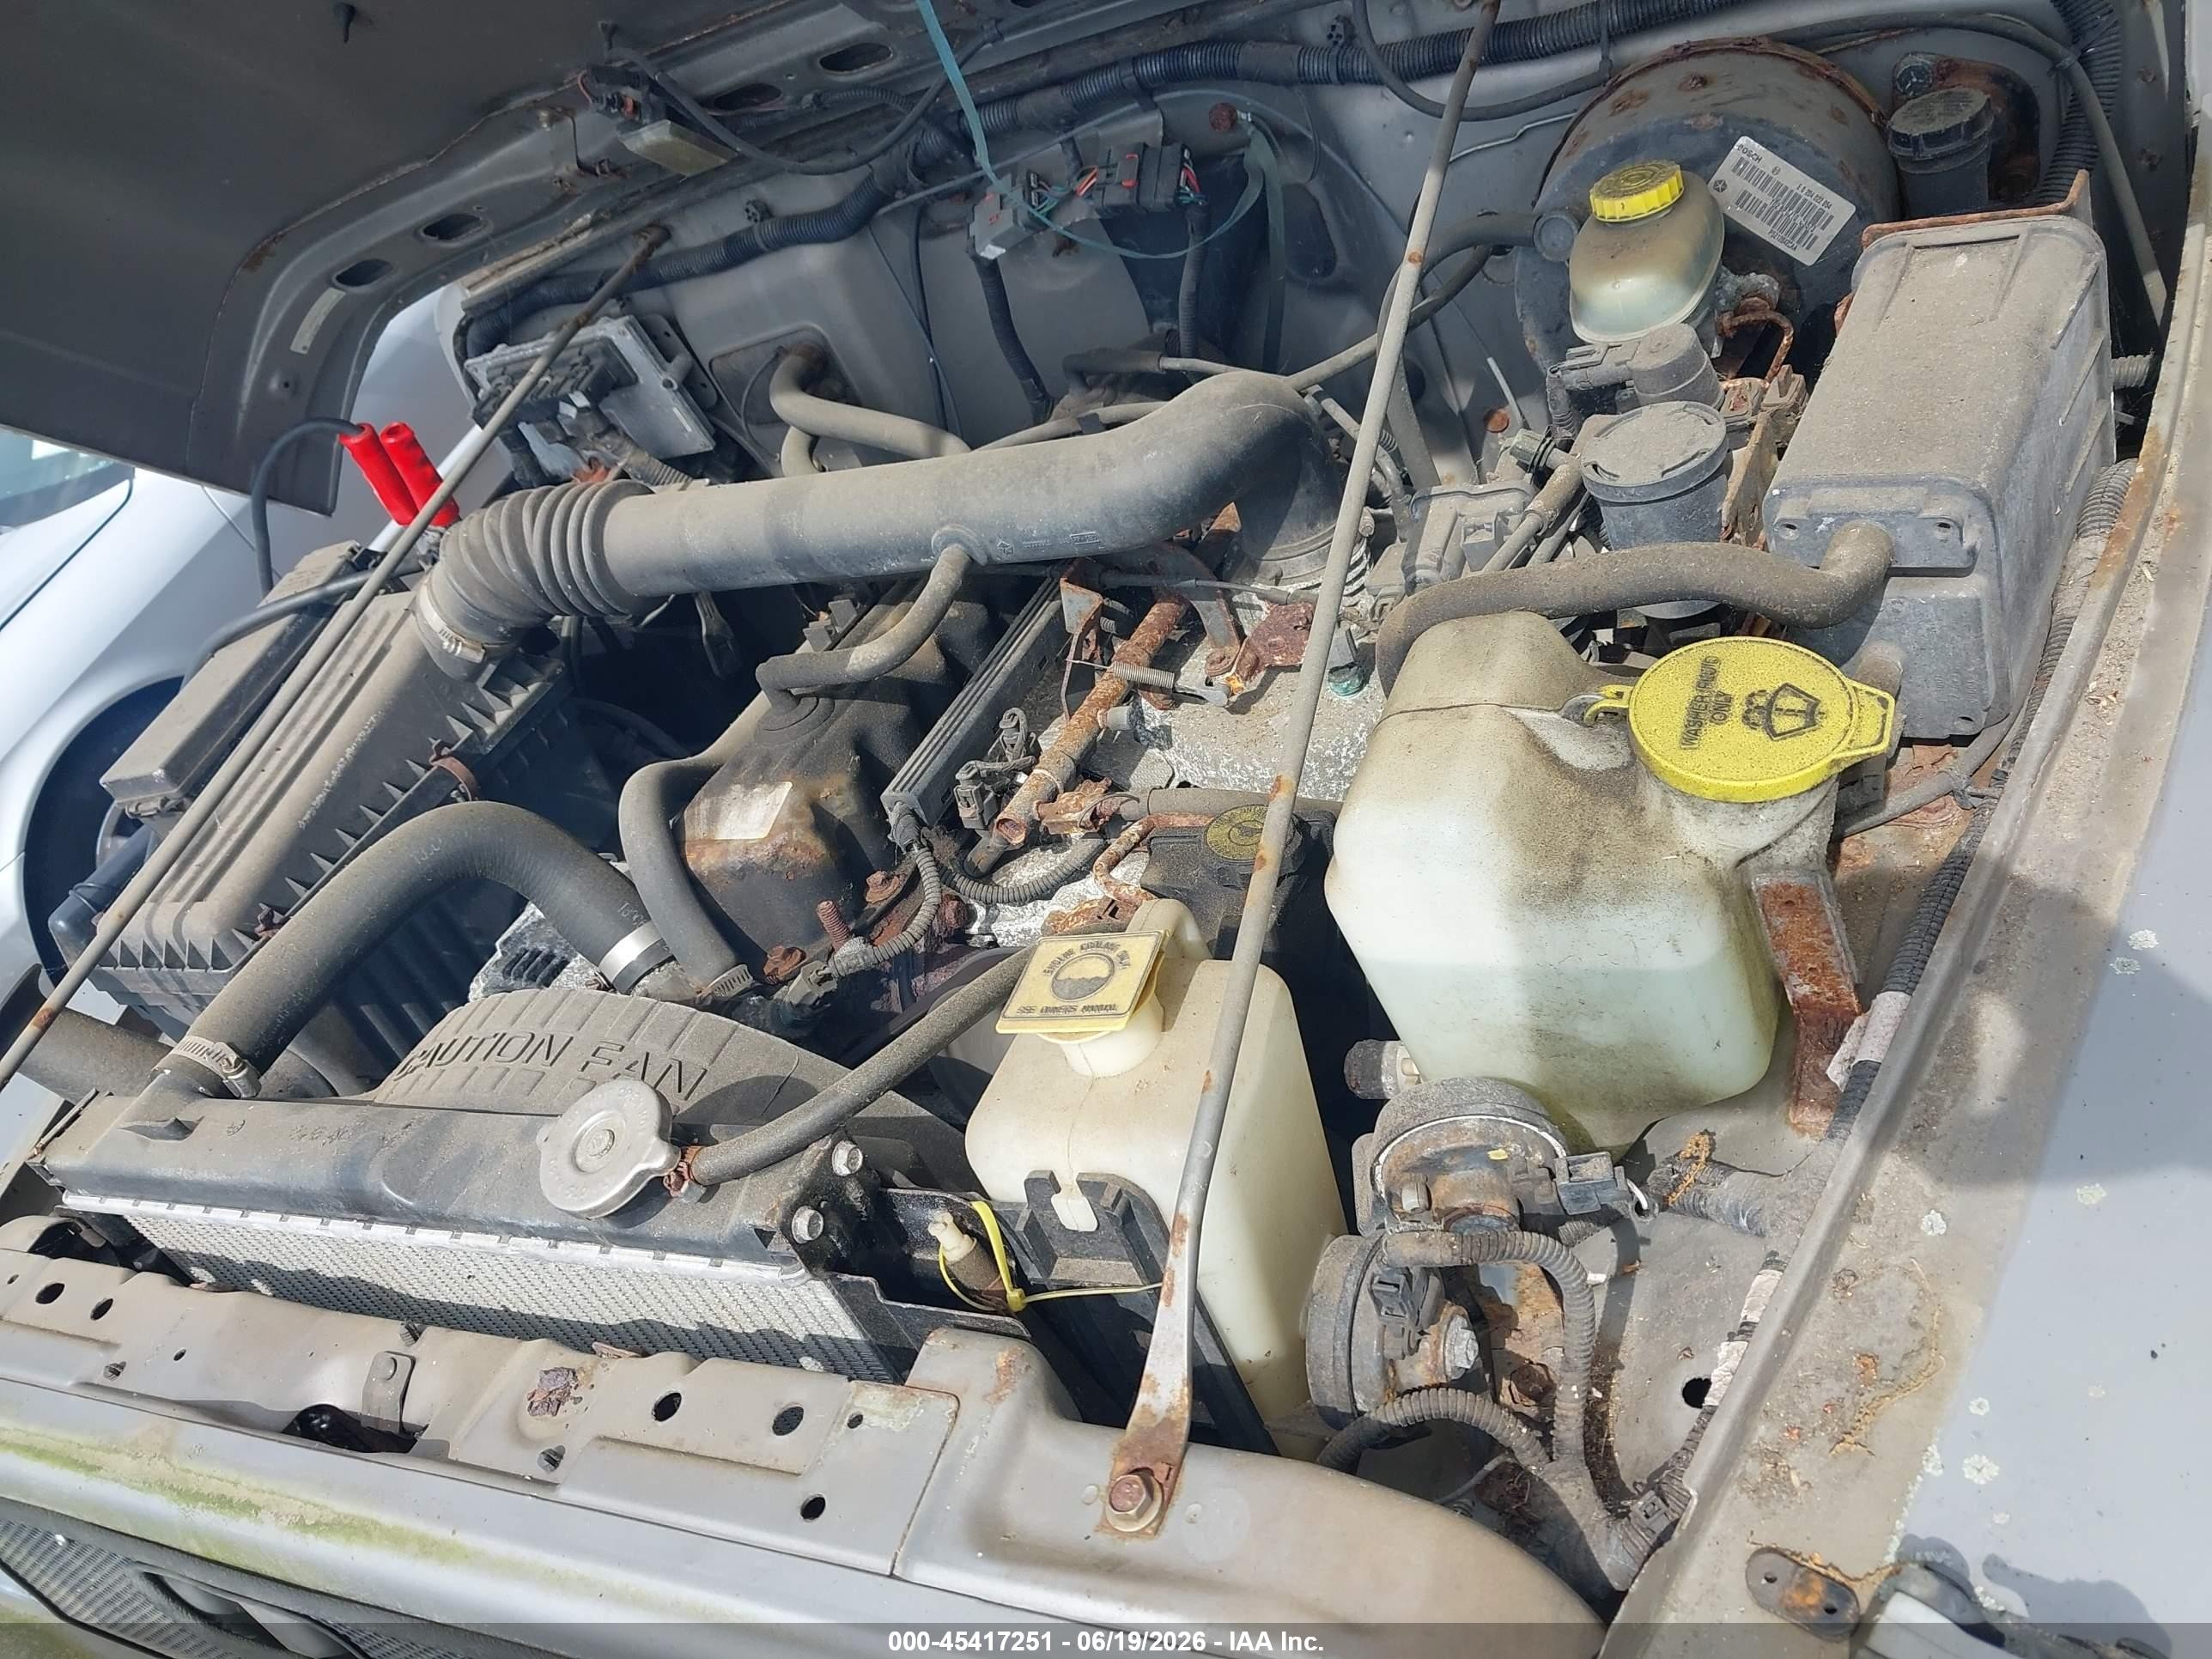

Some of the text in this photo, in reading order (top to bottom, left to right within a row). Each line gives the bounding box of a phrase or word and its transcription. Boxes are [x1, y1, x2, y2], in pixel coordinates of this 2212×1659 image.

[1737, 143, 1763, 164] BOSCH
[1680, 694, 1711, 749] WASHER
[1711, 690, 1733, 725] ONLY
[394, 1031, 708, 1102] CAUTION FAN
